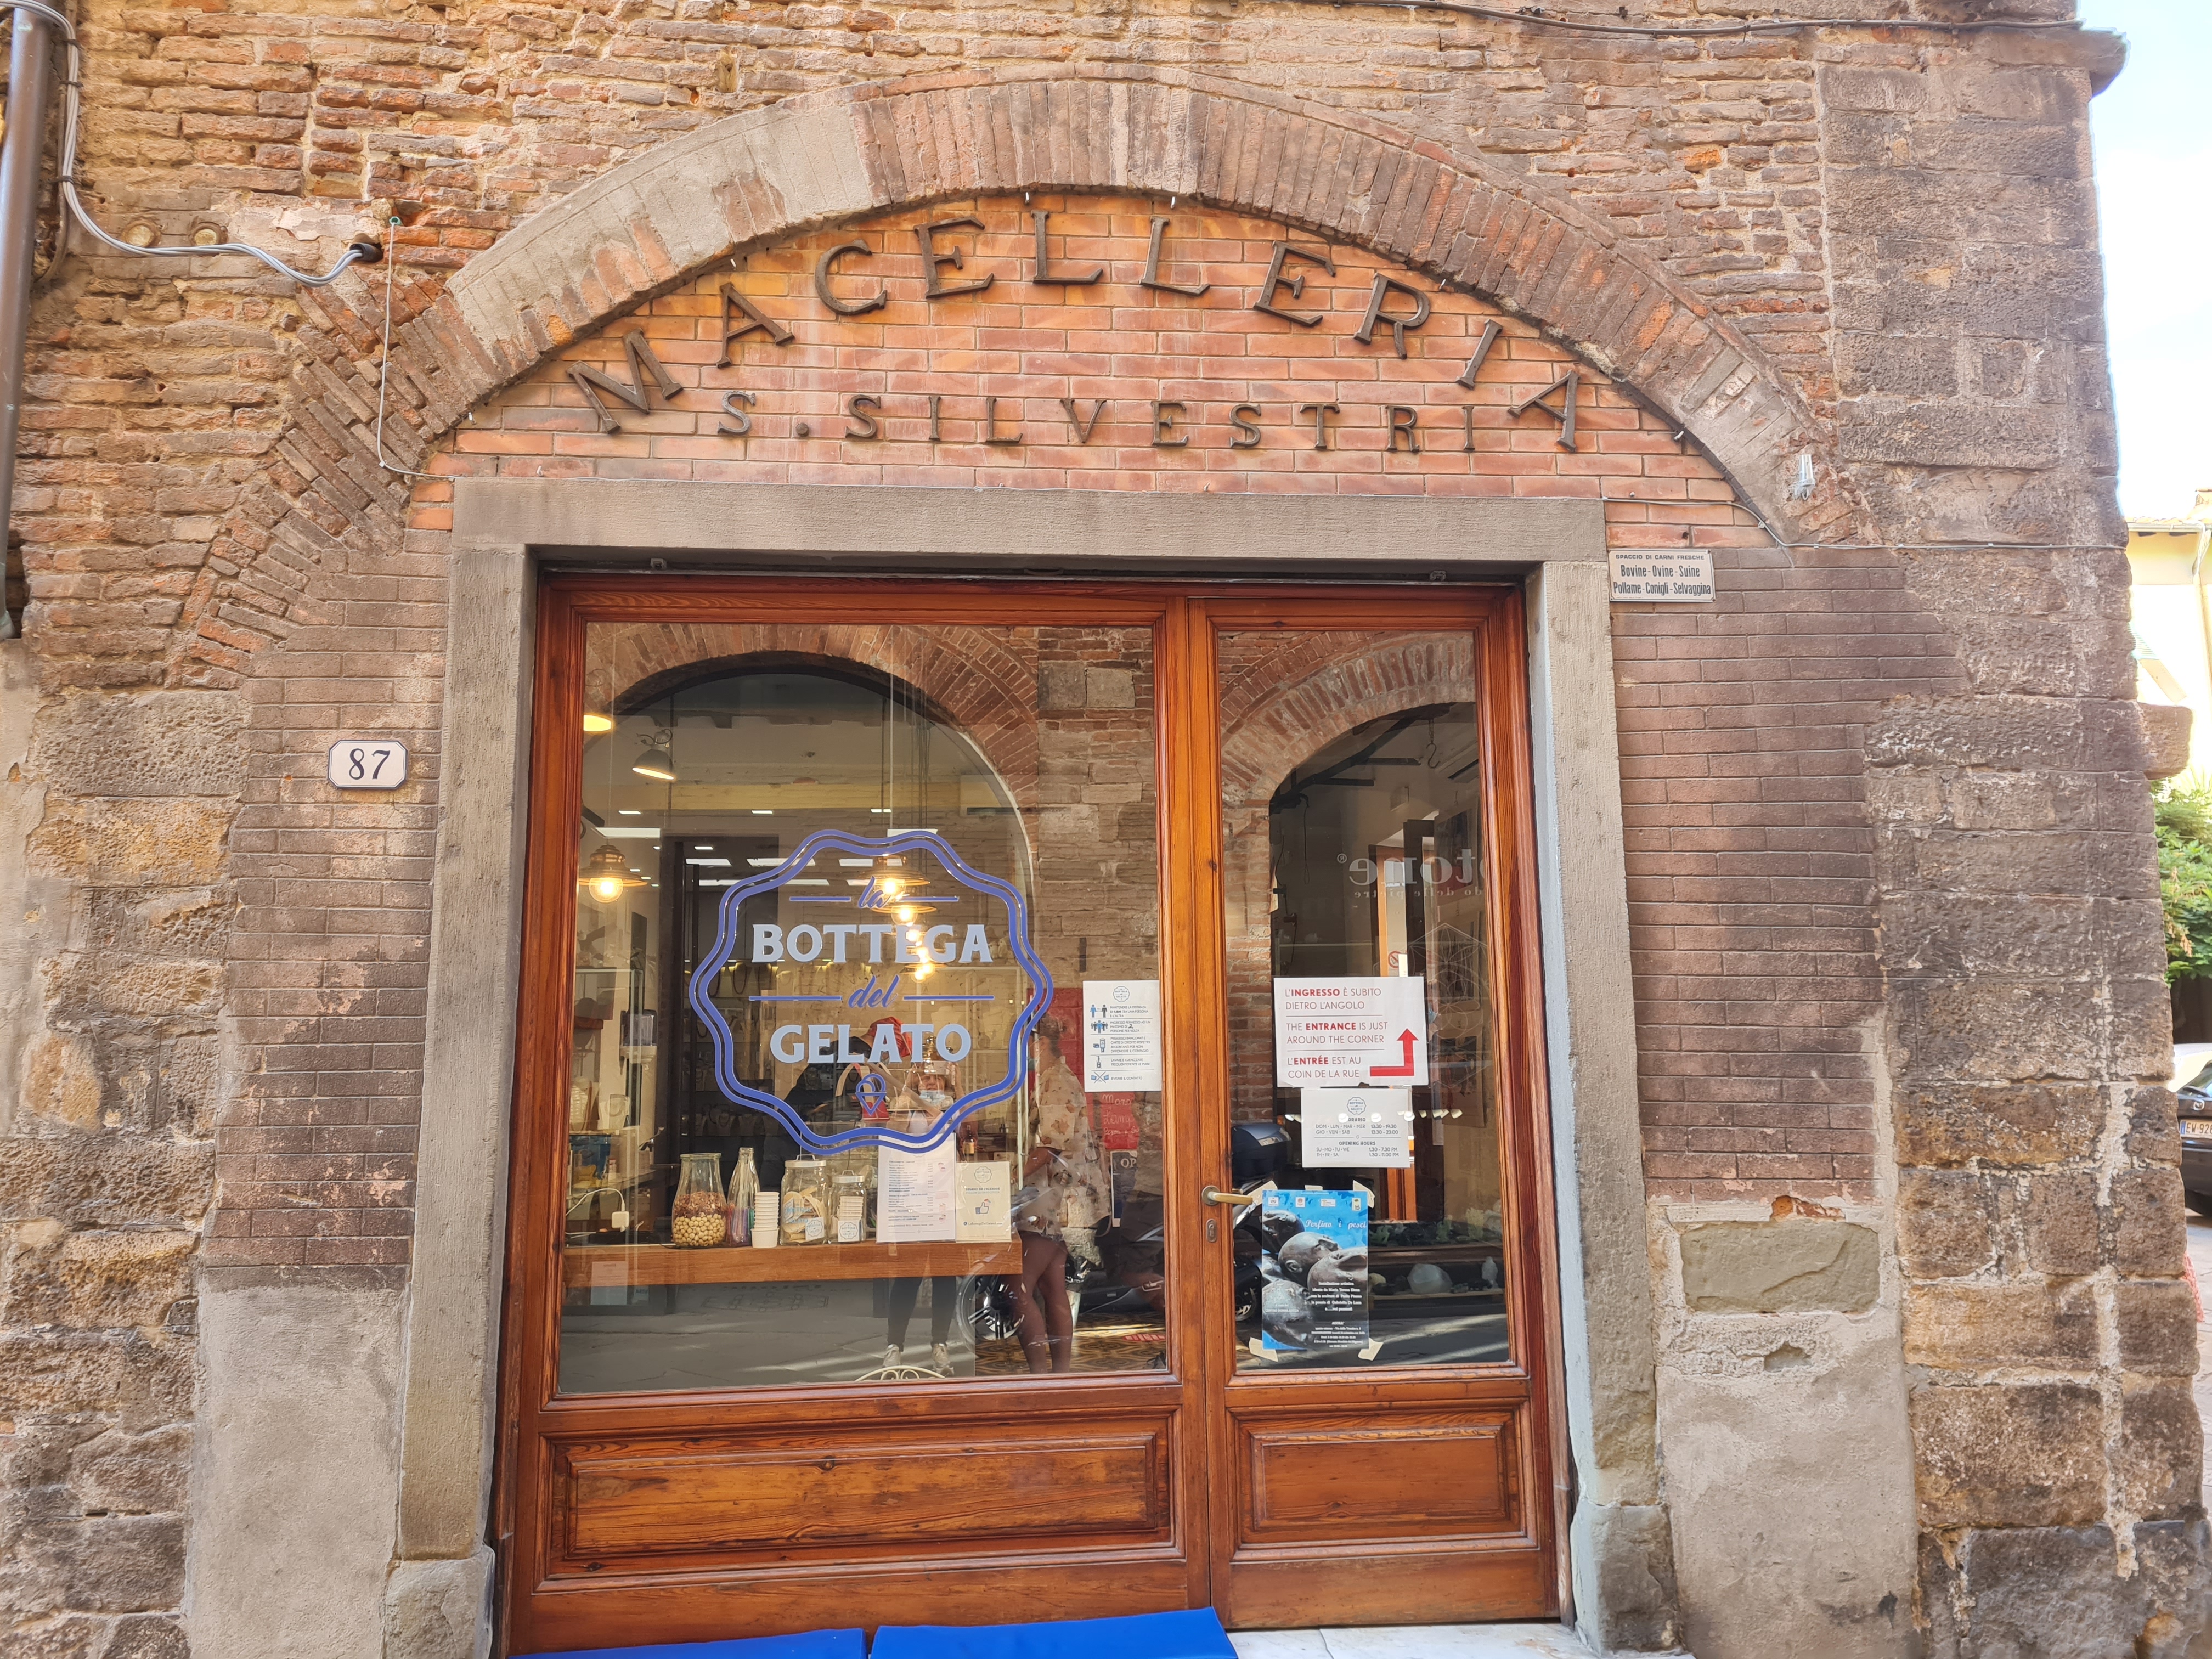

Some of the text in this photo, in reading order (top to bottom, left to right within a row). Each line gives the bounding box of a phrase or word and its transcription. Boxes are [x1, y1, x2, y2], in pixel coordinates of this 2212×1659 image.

[566, 210, 1595, 453] MACELLERIA
[1621, 565, 1647, 577] Bovine
[1652, 565, 1674, 577] Ovine
[1679, 565, 1700, 577] Suine
[1613, 582, 1641, 594] Pollame
[1645, 582, 1669, 596] Conigli
[1673, 582, 1711, 596] Selvaggina
[349, 748, 391, 780] 87
[857, 876, 891, 909] la
[752, 923, 994, 964] BOTTEGA
[848, 975, 900, 1008] del
[1285, 987, 1382, 997] L'INGRESSO È SUBITO
[1285, 1001, 1365, 1010] DIETRO L'ANGOLO
[1306, 1023, 1356, 1031] ENTRANCE
[1359, 1022, 1367, 1030] IS
[770, 1024, 972, 1063] GELATO
[1286, 1035, 1384, 1044] AROUND THE CORNER
[1287, 1055, 1361, 1065] L'ENTRÉE EST AU
[1288, 1070, 1312, 1079] COIN
[2186, 1122, 2197, 1133] EW
[1306, 1220, 1332, 1230] Perfino
[1348, 1221, 1367, 1231] pesci
